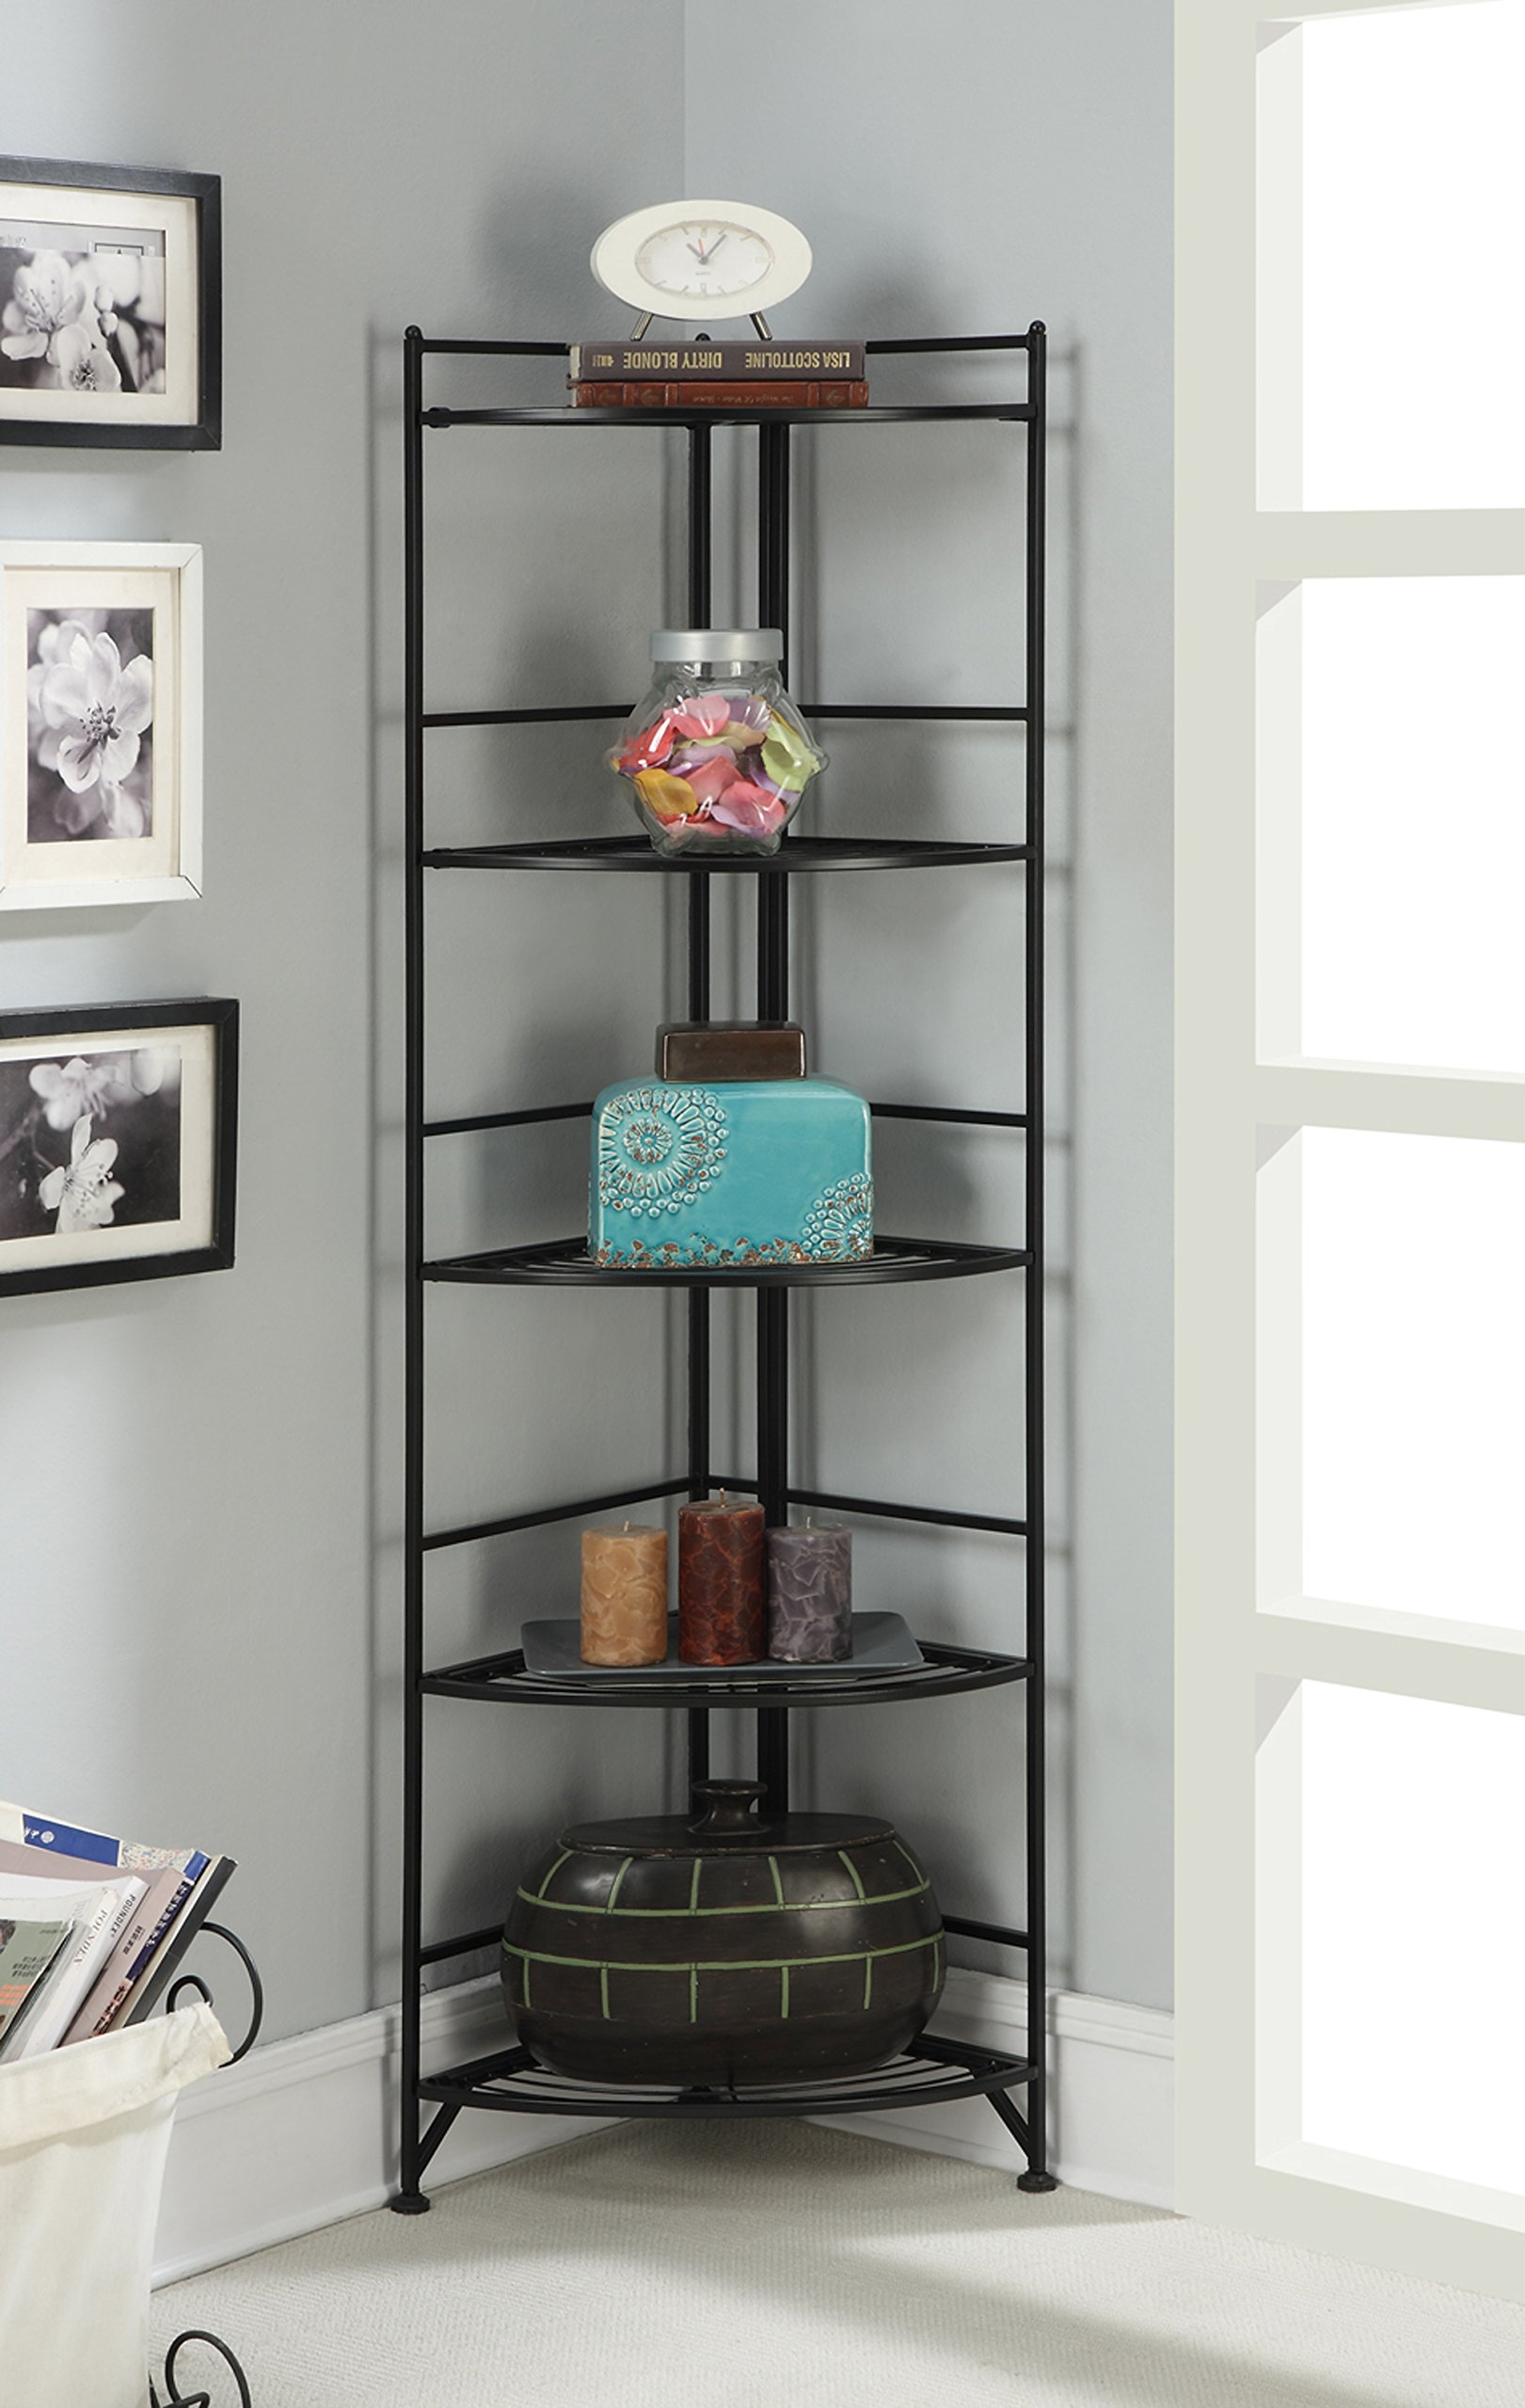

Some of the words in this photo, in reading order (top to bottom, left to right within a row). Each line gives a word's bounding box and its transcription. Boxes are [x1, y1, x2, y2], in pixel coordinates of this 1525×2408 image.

[623, 351, 678, 369] BLONDE
[681, 351, 723, 369] DIRTY
[745, 351, 820, 369] SCOTTOLINE
[822, 351, 850, 368] LISA
